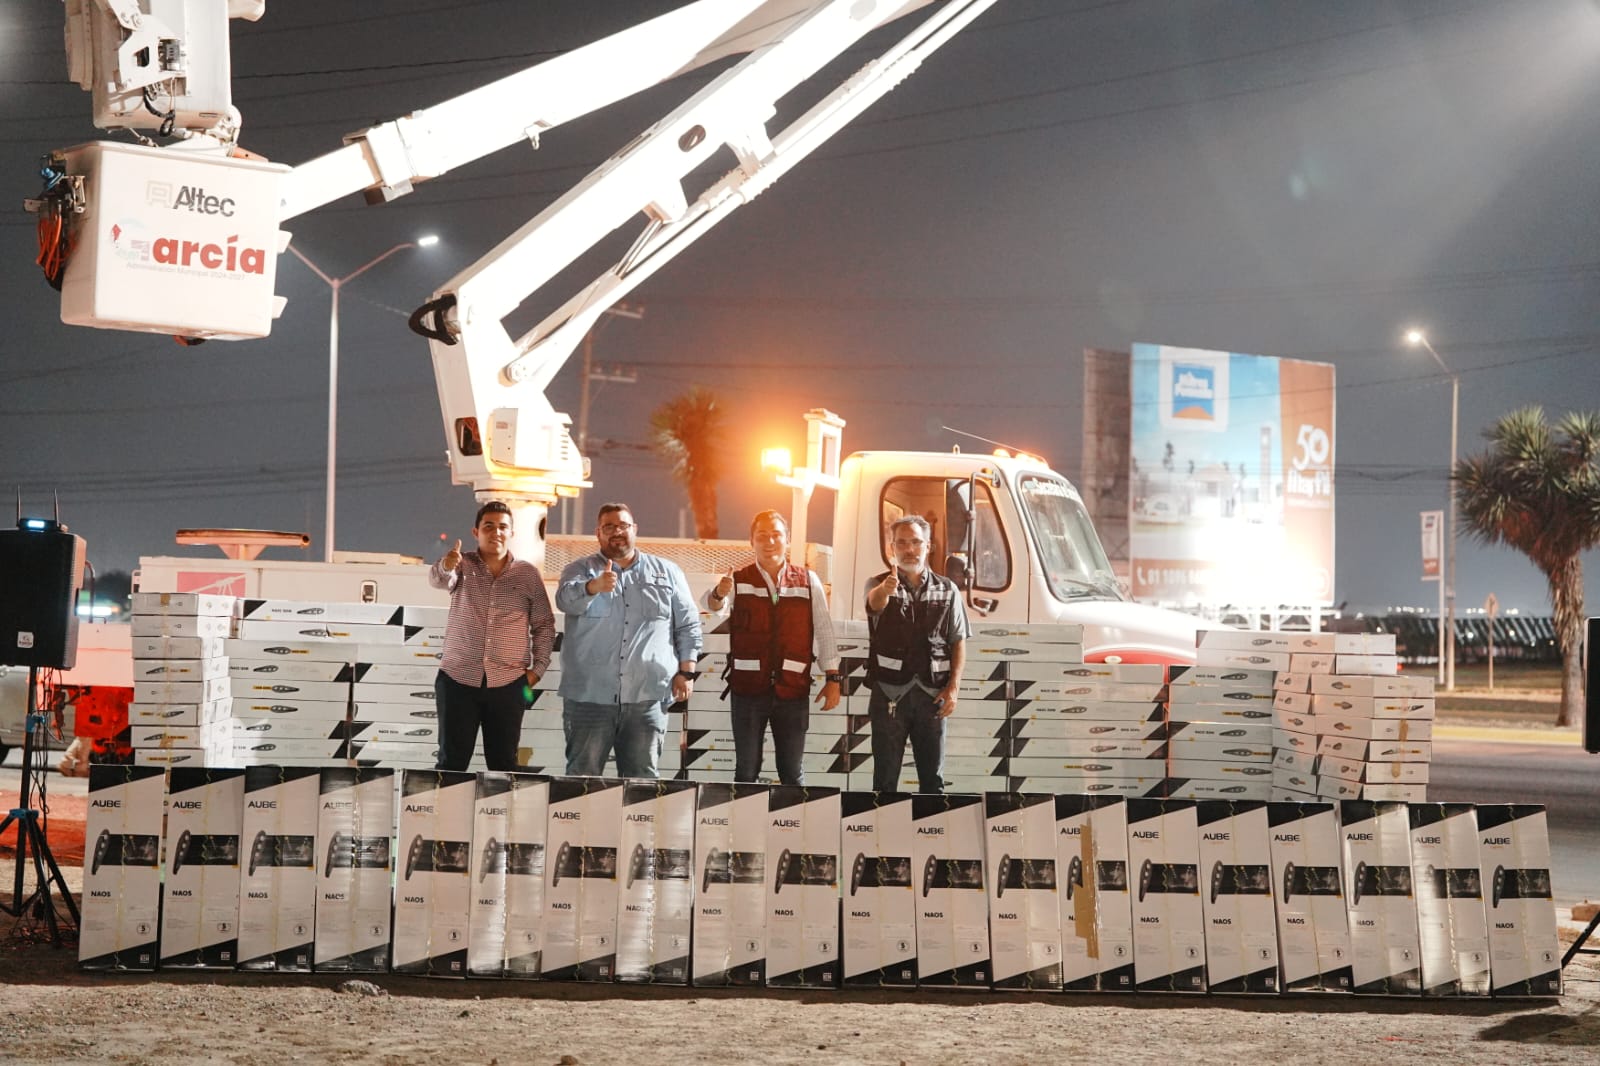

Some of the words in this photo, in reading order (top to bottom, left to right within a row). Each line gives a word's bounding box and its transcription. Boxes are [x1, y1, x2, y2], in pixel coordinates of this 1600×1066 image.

[173, 186, 235, 217] Altec
[1292, 424, 1330, 471] 50
[91, 800, 121, 808] AUBE
[172, 801, 202, 809] AUBE
[247, 800, 277, 809] AUBE
[405, 805, 434, 813] AUBE
[552, 812, 581, 820] AUBE
[626, 815, 654, 823] AUBE
[700, 818, 729, 826] AUBE
[772, 819, 800, 827] AUBE
[917, 827, 944, 835] AUBE
[1060, 827, 1082, 835] AUB
[1132, 831, 1160, 839] AUBE
[1203, 833, 1230, 841] AUBE
[1274, 834, 1300, 842] AUBE
[1346, 833, 1373, 841] AUBE
[404, 896, 424, 904] NAOS
